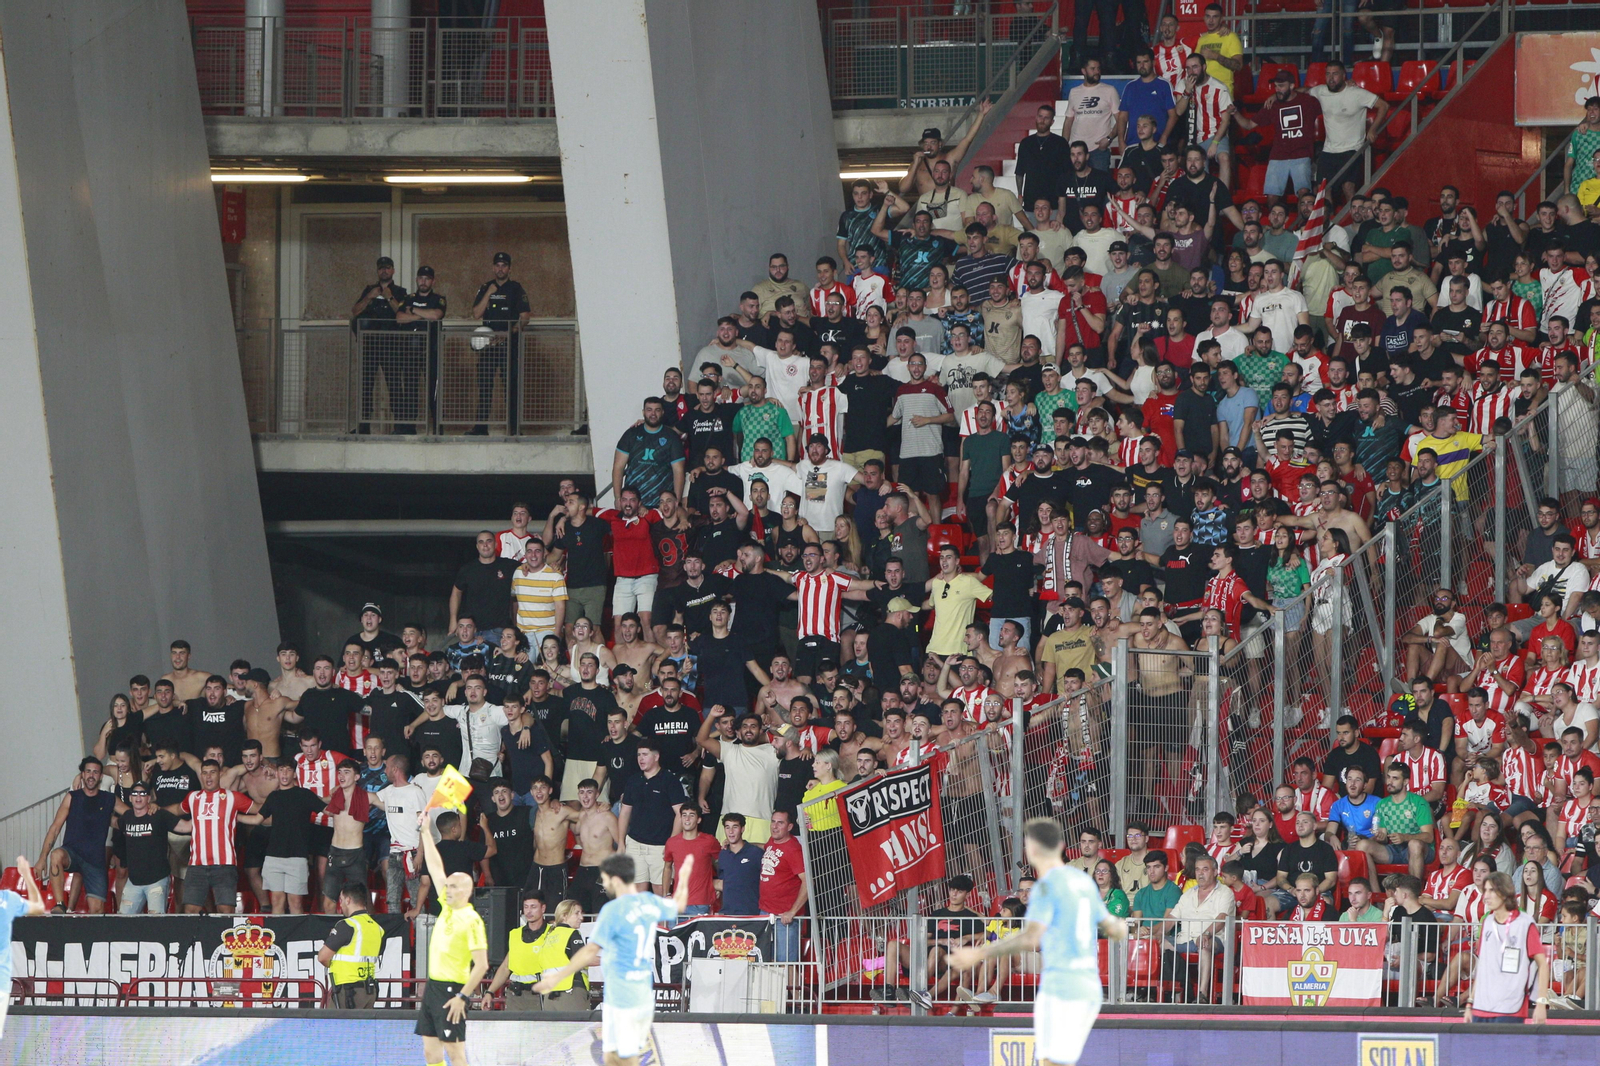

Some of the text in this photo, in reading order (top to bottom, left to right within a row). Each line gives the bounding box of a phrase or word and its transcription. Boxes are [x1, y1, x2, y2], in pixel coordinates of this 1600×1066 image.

[1180, 3, 1197, 15] 141
[900, 98, 977, 109] ESTRELLA
[1281, 130, 1303, 139] FILA
[203, 711, 225, 723] VANS
[654, 722, 689, 731] ALMERIA
[1249, 924, 1378, 947] PEÑA LA UVA
[1294, 982, 1327, 990] ALMERIA
